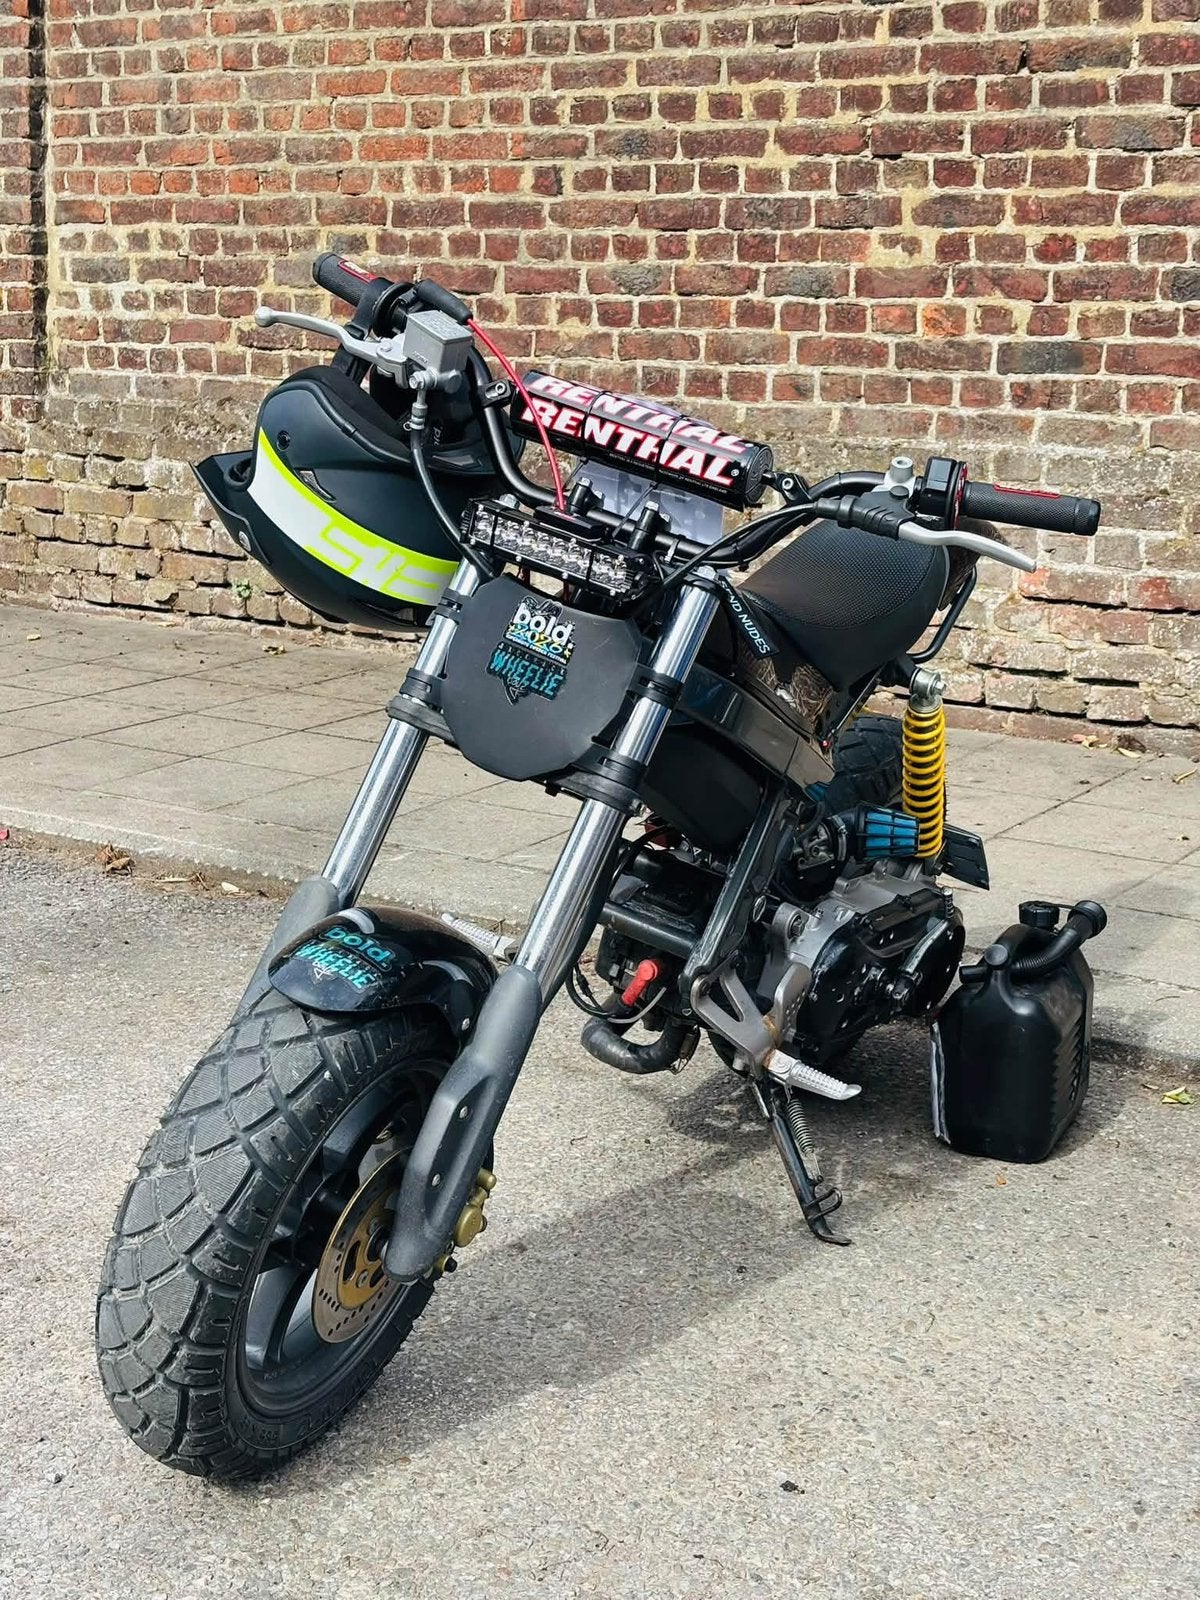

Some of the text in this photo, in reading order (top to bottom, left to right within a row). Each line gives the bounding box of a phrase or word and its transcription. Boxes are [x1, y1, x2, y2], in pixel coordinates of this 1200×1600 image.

[530, 376, 746, 453] RENTHAL
[521, 396, 734, 487] RENTHAL
[509, 622, 564, 655] 2026
[738, 613, 771, 654] NUDES
[489, 648, 564, 696] WHEELIE
[295, 943, 376, 989] WHEELIE
